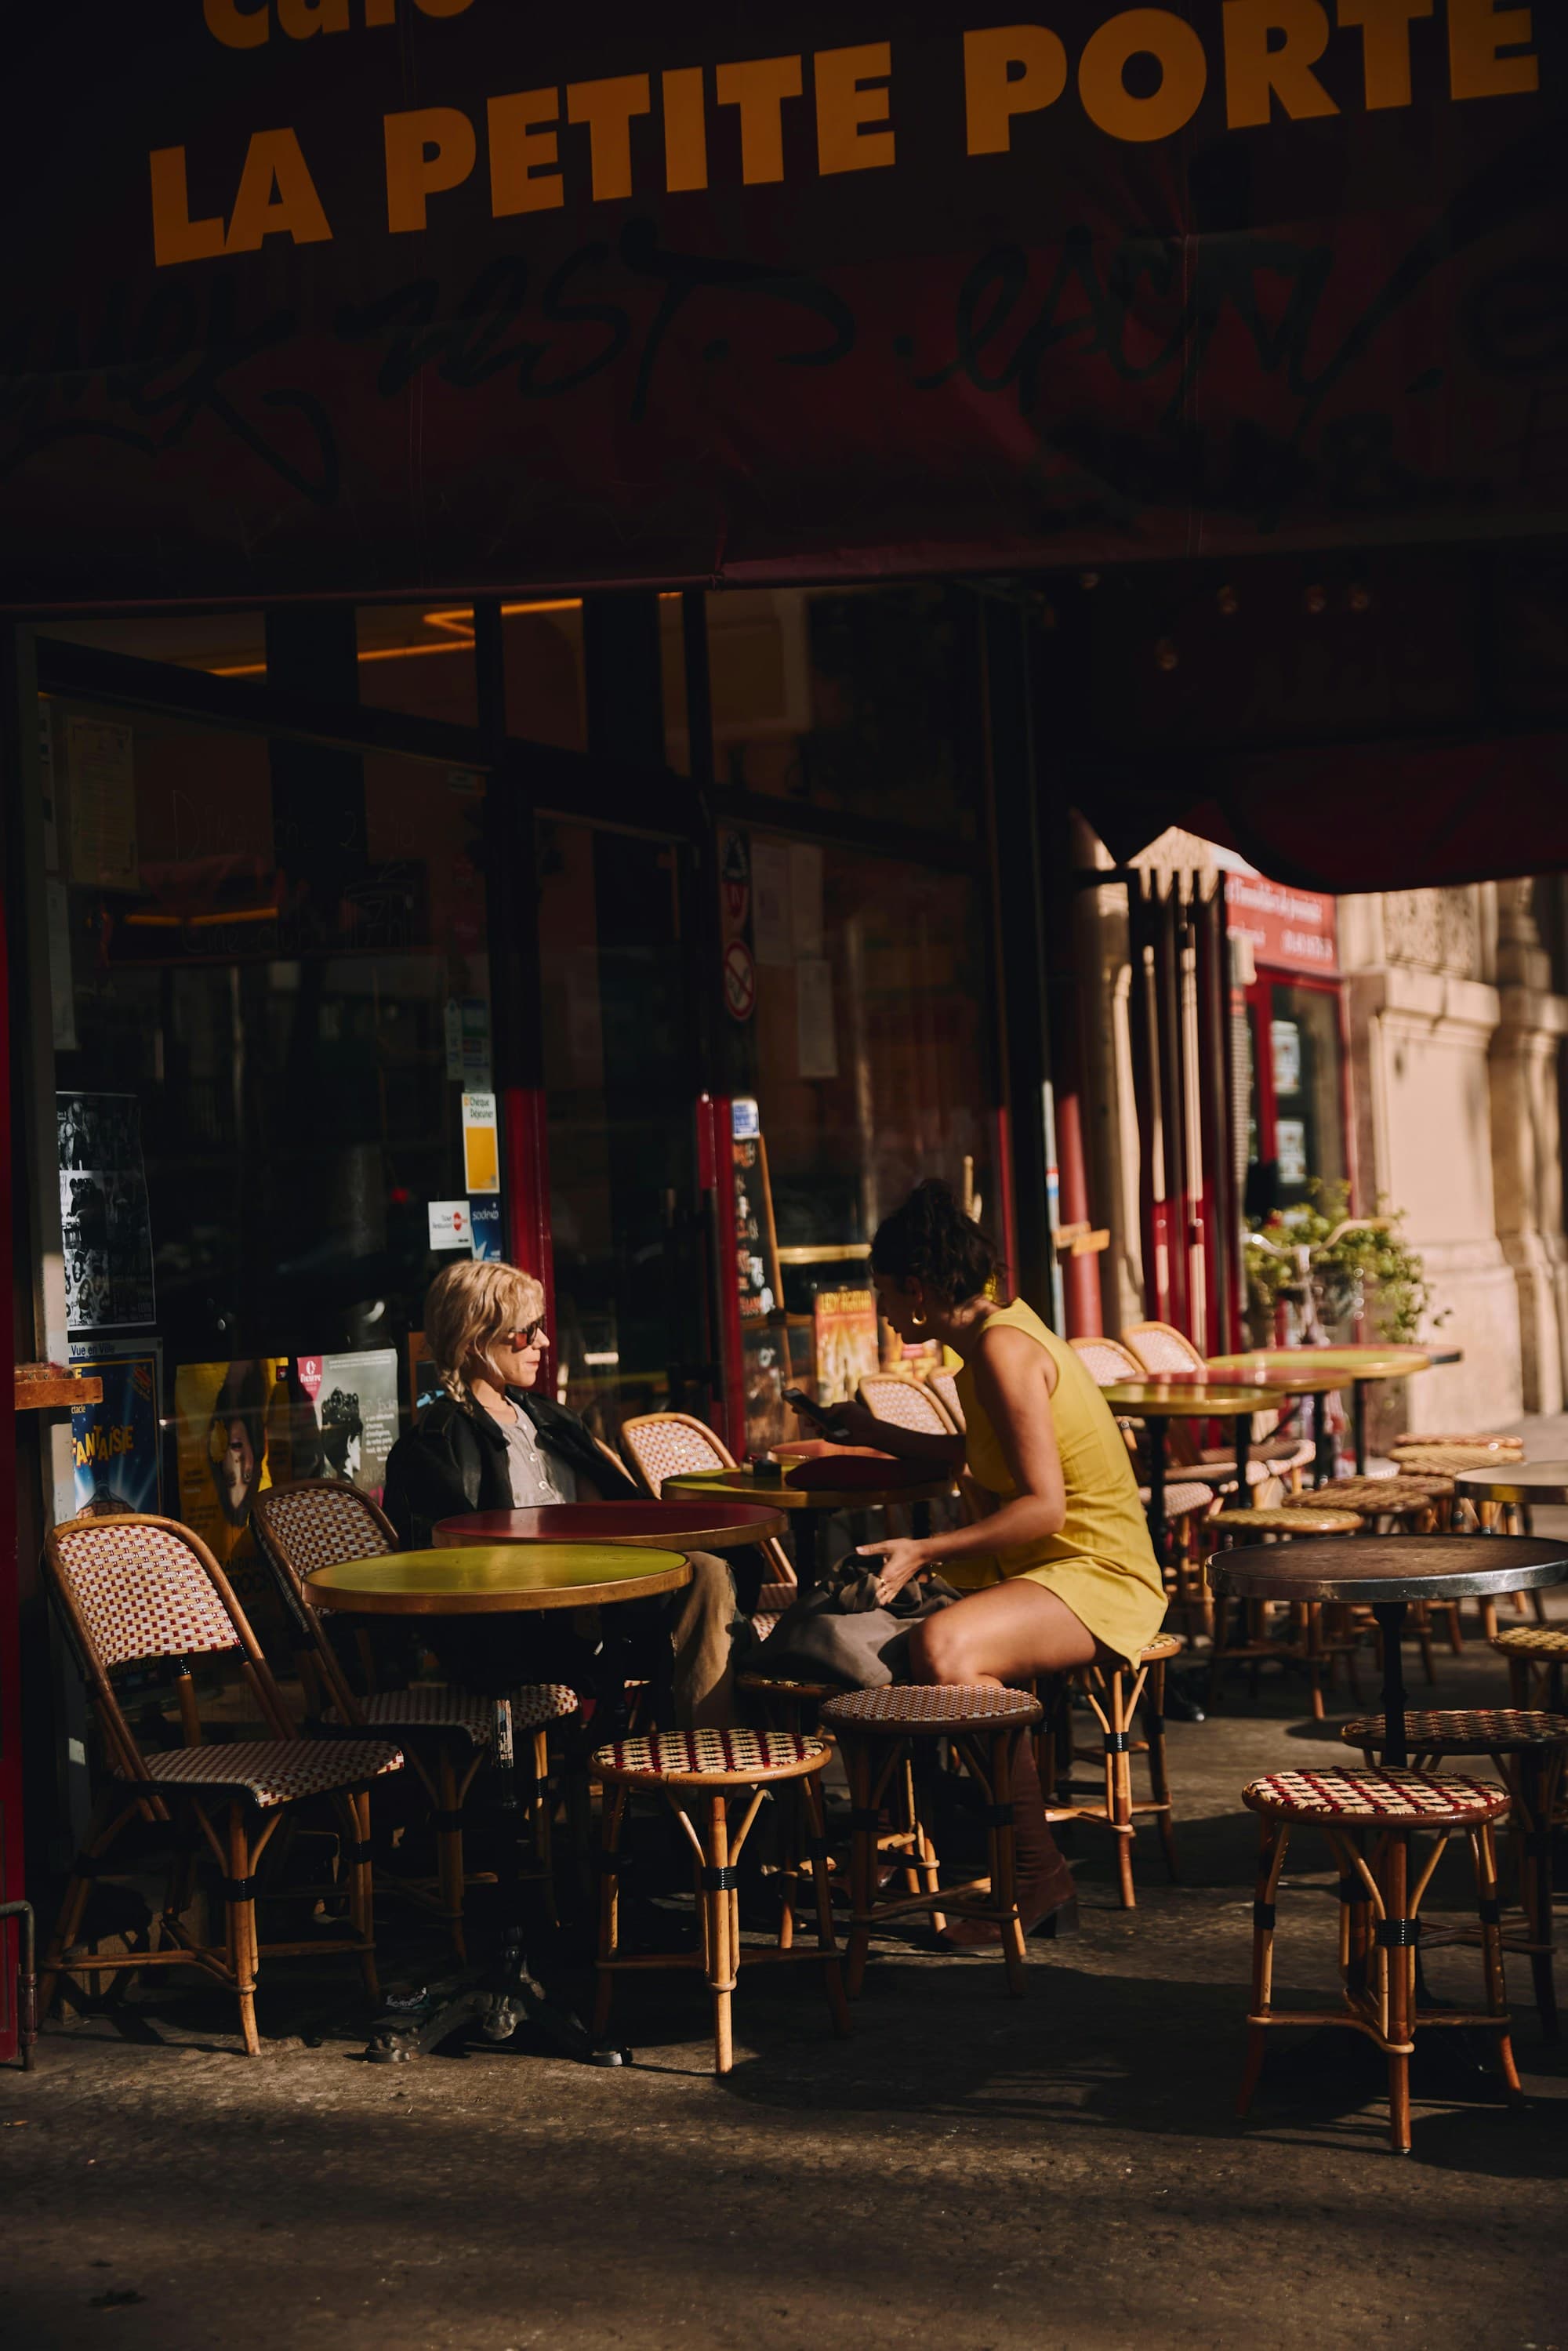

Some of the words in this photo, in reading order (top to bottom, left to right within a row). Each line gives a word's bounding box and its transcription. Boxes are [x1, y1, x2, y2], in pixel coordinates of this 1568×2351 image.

[150, 128, 334, 267] LA
[383, 41, 895, 234] PETITE
[963, 0, 1539, 156] PORTE
[71, 1344, 86, 1356] Vue
[88, 1345, 98, 1355] en
[99, 1342, 115, 1355] Ville
